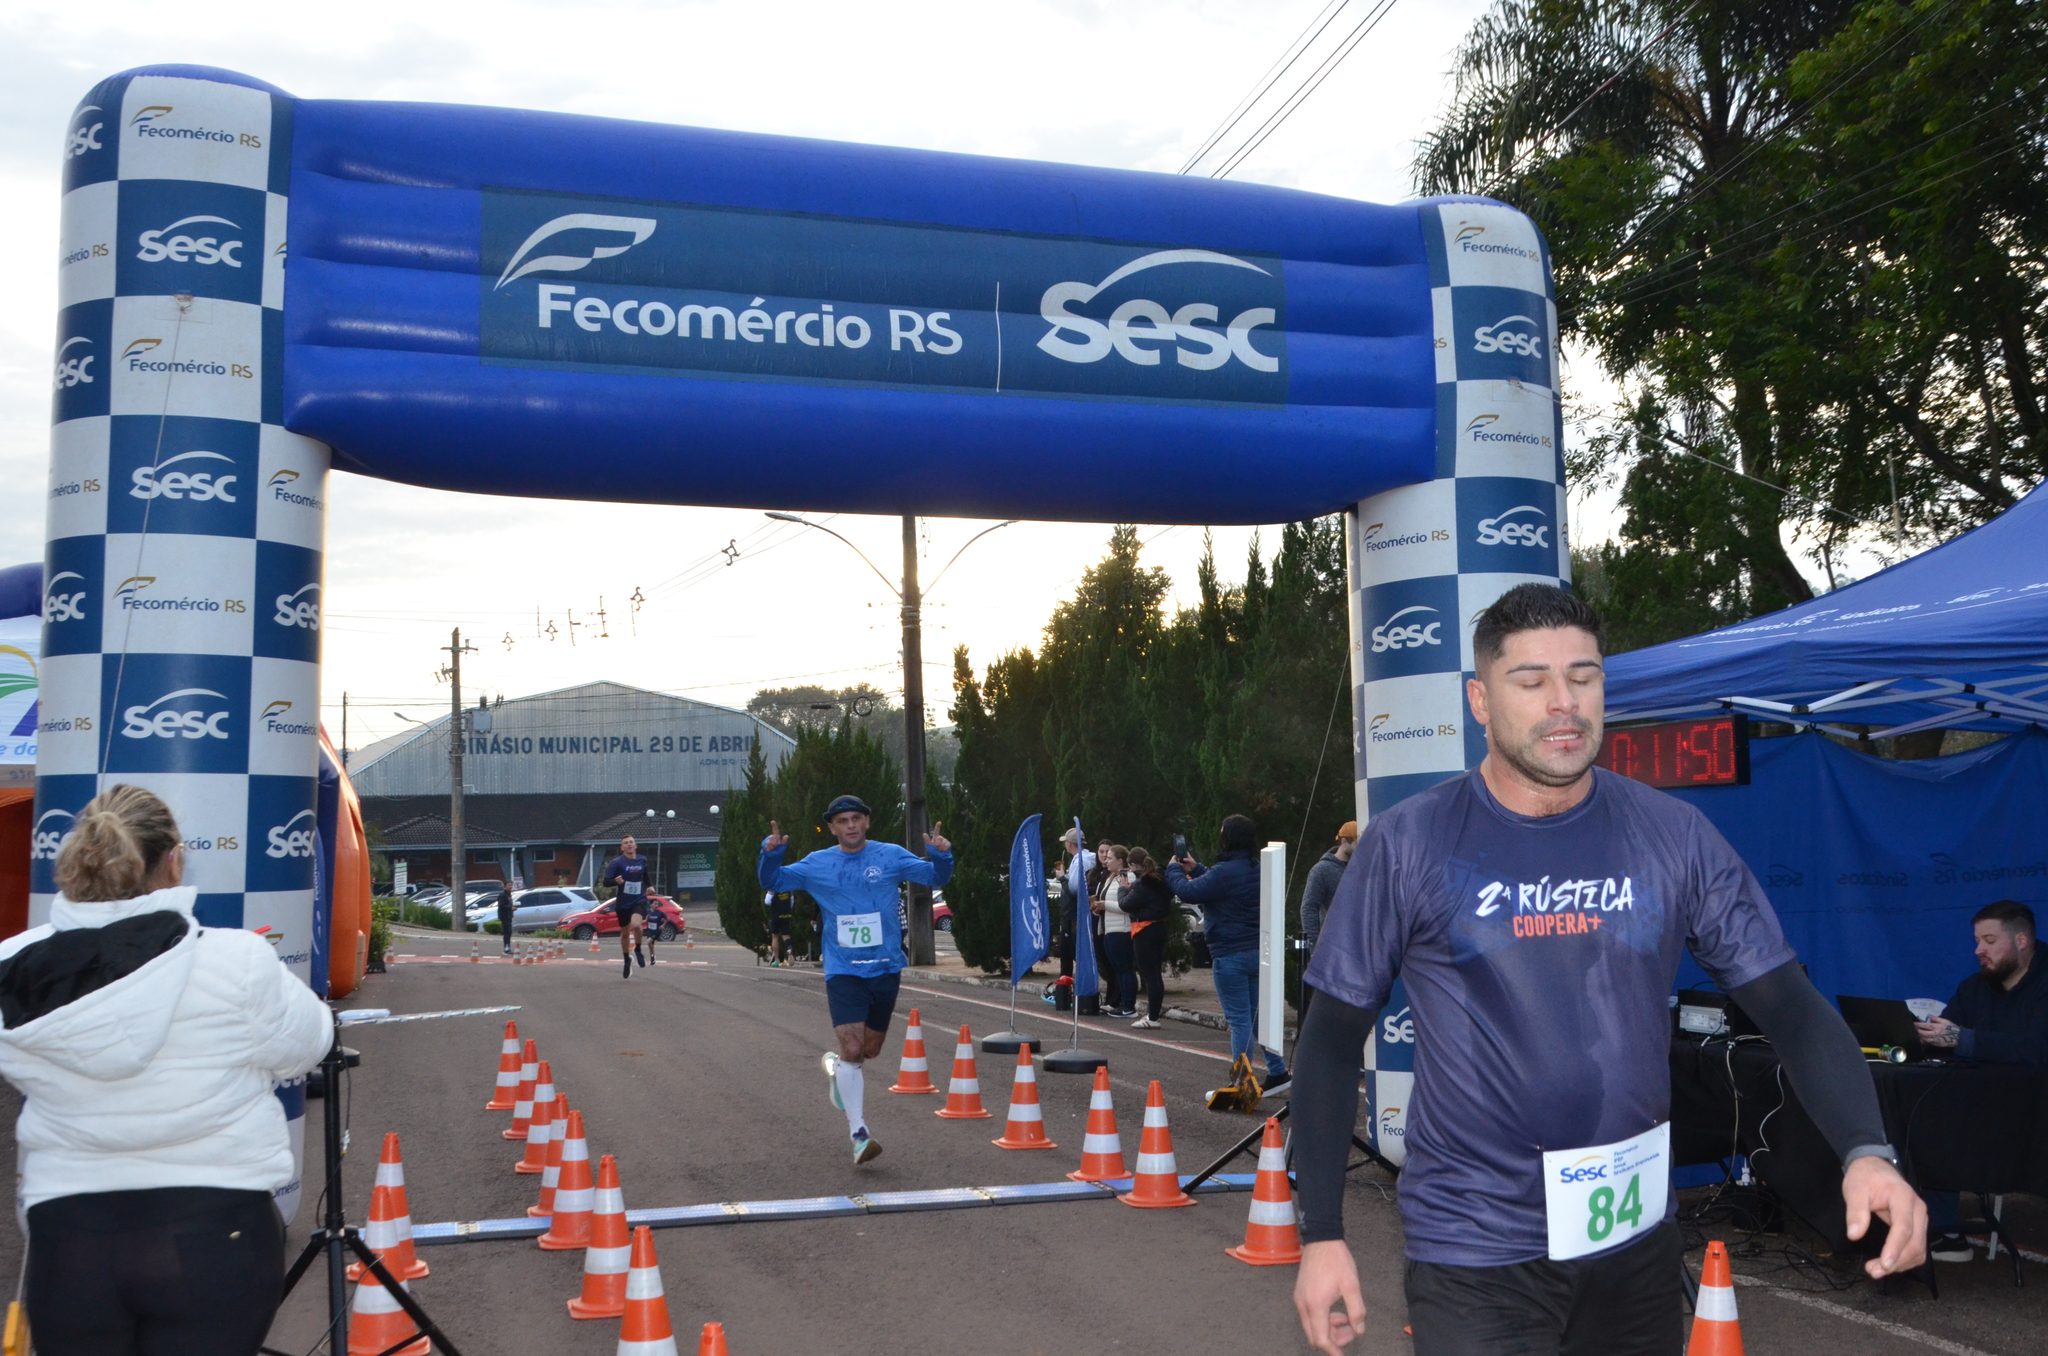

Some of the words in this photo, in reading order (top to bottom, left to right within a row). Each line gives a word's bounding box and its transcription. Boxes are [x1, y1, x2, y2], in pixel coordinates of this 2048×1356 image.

[64, 123, 103, 160] esc
[139, 124, 235, 144] Fecomércio
[240, 133, 262, 149] RS
[92, 244, 109, 257] RS
[136, 228, 243, 268] Sesc
[1463, 241, 1527, 258] Fecomércio
[1529, 249, 1540, 263] RS
[538, 283, 872, 350] Fecomércio
[890, 308, 963, 356] RS
[1036, 280, 1279, 373] Sesc
[1473, 325, 1542, 360] Sesc
[55, 355, 94, 390] esc
[129, 357, 226, 376] Fecomércio
[231, 363, 253, 380] RS
[1474, 430, 1539, 447] Fecomércio
[1541, 436, 1552, 449] RS
[84, 479, 101, 493] RS
[129, 465, 237, 503] Sesc
[1366, 531, 1427, 552] Fecomércio
[1431, 529, 1450, 541] RS
[1476, 517, 1549, 548] Sesc
[46, 591, 86, 623] esc
[122, 596, 220, 613] Fecomércio
[224, 599, 246, 614] RS
[273, 593, 320, 630] Ses
[1371, 621, 1442, 653] Sesc
[74, 716, 92, 731] RS
[121, 705, 229, 740] Sesc
[1372, 726, 1434, 743] Fecomércio
[1438, 724, 1456, 736] RS
[539, 736, 643, 755] MUNICIPAL
[650, 736, 674, 753] 29
[679, 736, 702, 753] DE
[217, 837, 239, 851] RS
[1518, 875, 1635, 917] RÚSTICA
[849, 926, 872, 945] 78
[1383, 1015, 1415, 1044] Se
[1560, 1163, 1607, 1183] Sesc
[1587, 1172, 1643, 1242] 84
